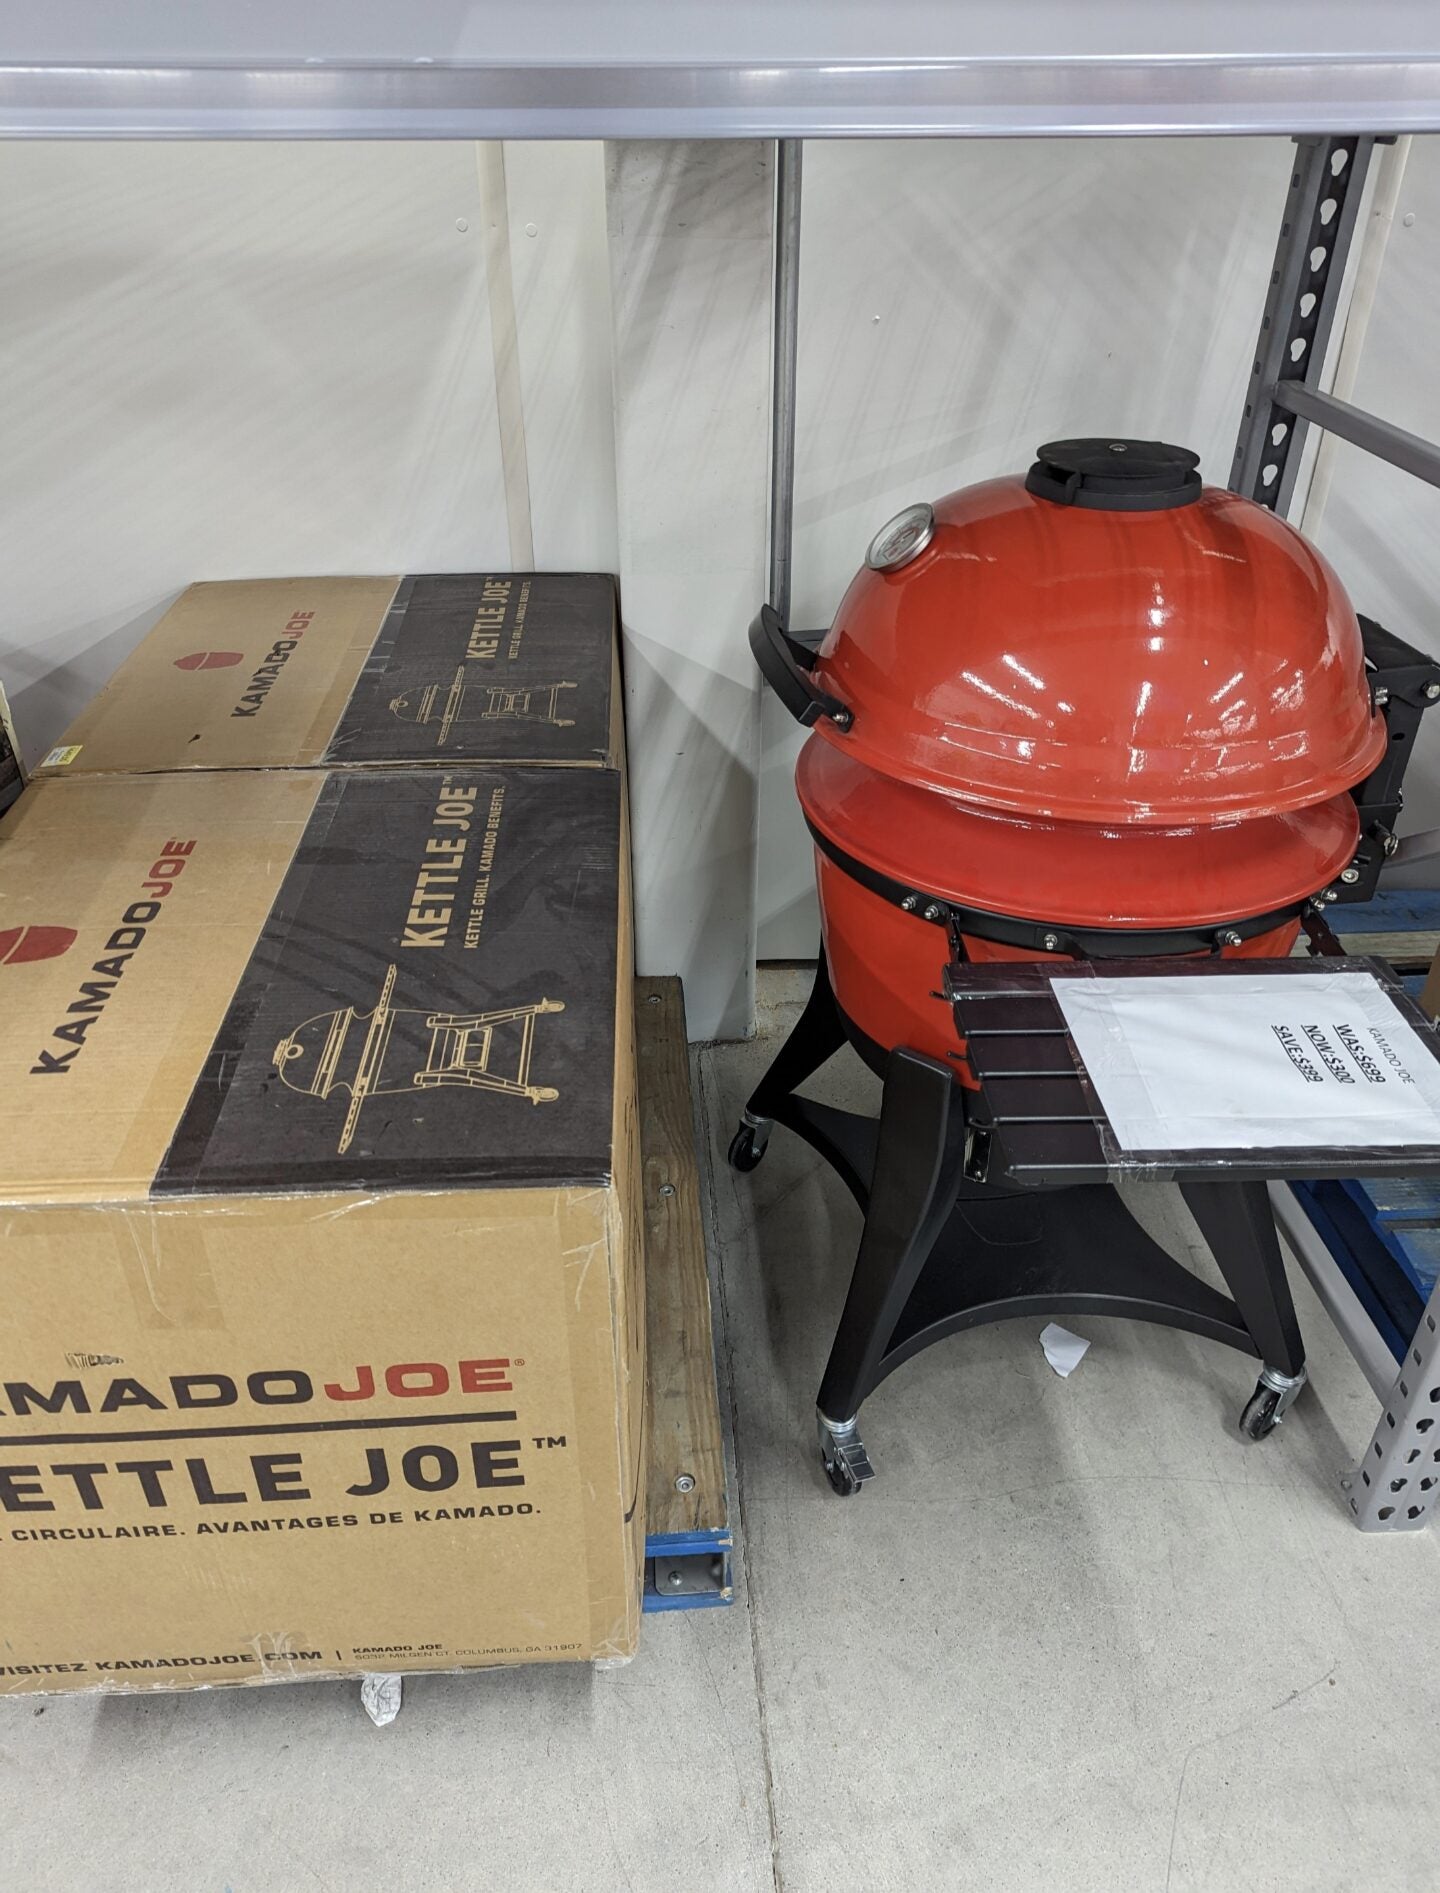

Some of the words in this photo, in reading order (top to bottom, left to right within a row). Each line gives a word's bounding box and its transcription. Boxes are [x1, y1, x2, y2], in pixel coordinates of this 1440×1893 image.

[465, 607, 506, 659] KETTLE
[487, 785, 506, 830] BENEFITS.
[478, 831, 498, 872] KAMADO
[400, 838, 467, 948] KETTLE
[472, 873, 490, 906] GRILL.
[463, 908, 484, 949] KETTLE
[1272, 1024, 1324, 1084] SAVE:$399
[1302, 1024, 1356, 1084] NOW:$300
[1334, 1024, 1386, 1084] WAS:$699
[1366, 1027, 1402, 1067] KAMADO
[1394, 1066, 1416, 1086] JOE
[11, 1524, 186, 1541] CIRCULAIRE.
[197, 1514, 358, 1535] AVANTAGES
[369, 1511, 404, 1525] DE
[414, 1503, 541, 1522] KAMADO.
[95, 1651, 323, 1672] KAMADOJOE.COM
[352, 1645, 413, 1654] KAMADO
